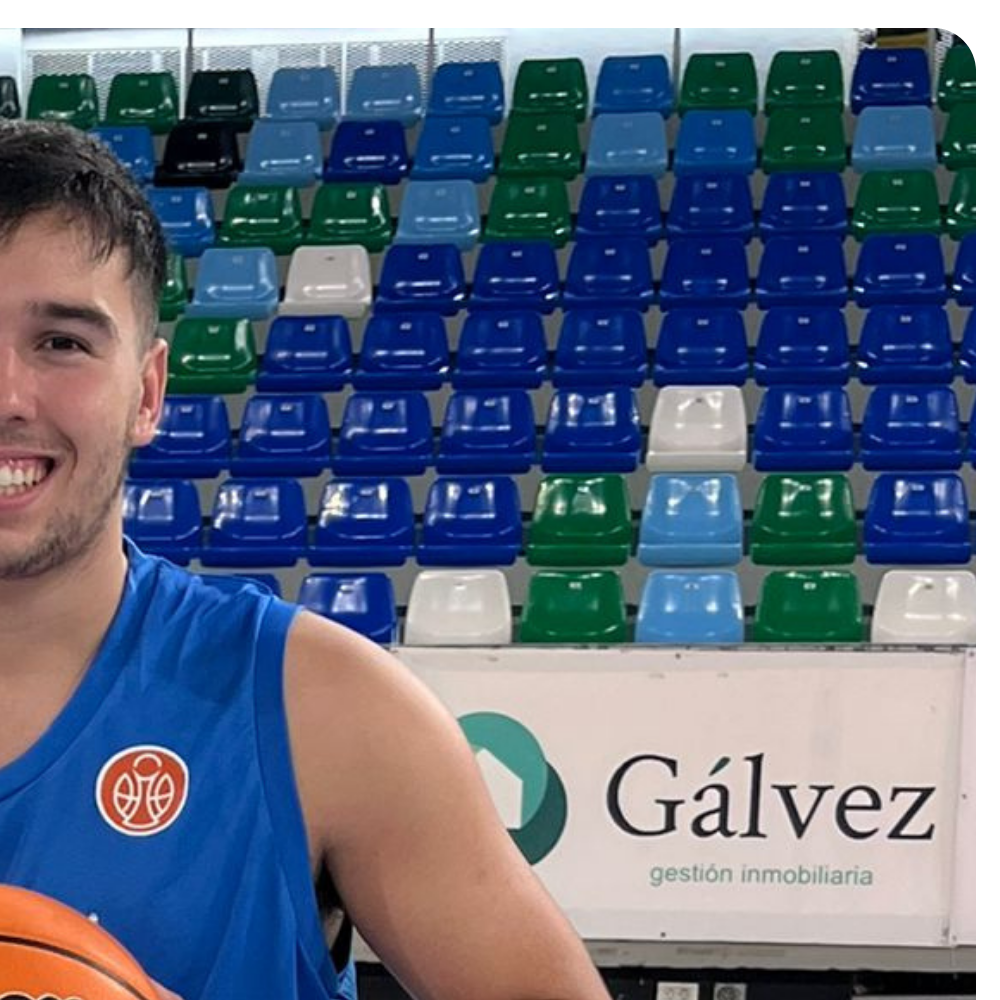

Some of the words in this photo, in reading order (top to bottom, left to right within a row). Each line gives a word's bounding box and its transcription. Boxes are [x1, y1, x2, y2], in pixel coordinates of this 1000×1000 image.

[606, 753, 937, 840] Gálvez
[649, 865, 733, 887] gestión
[741, 866, 875, 886] inmobiliaria
